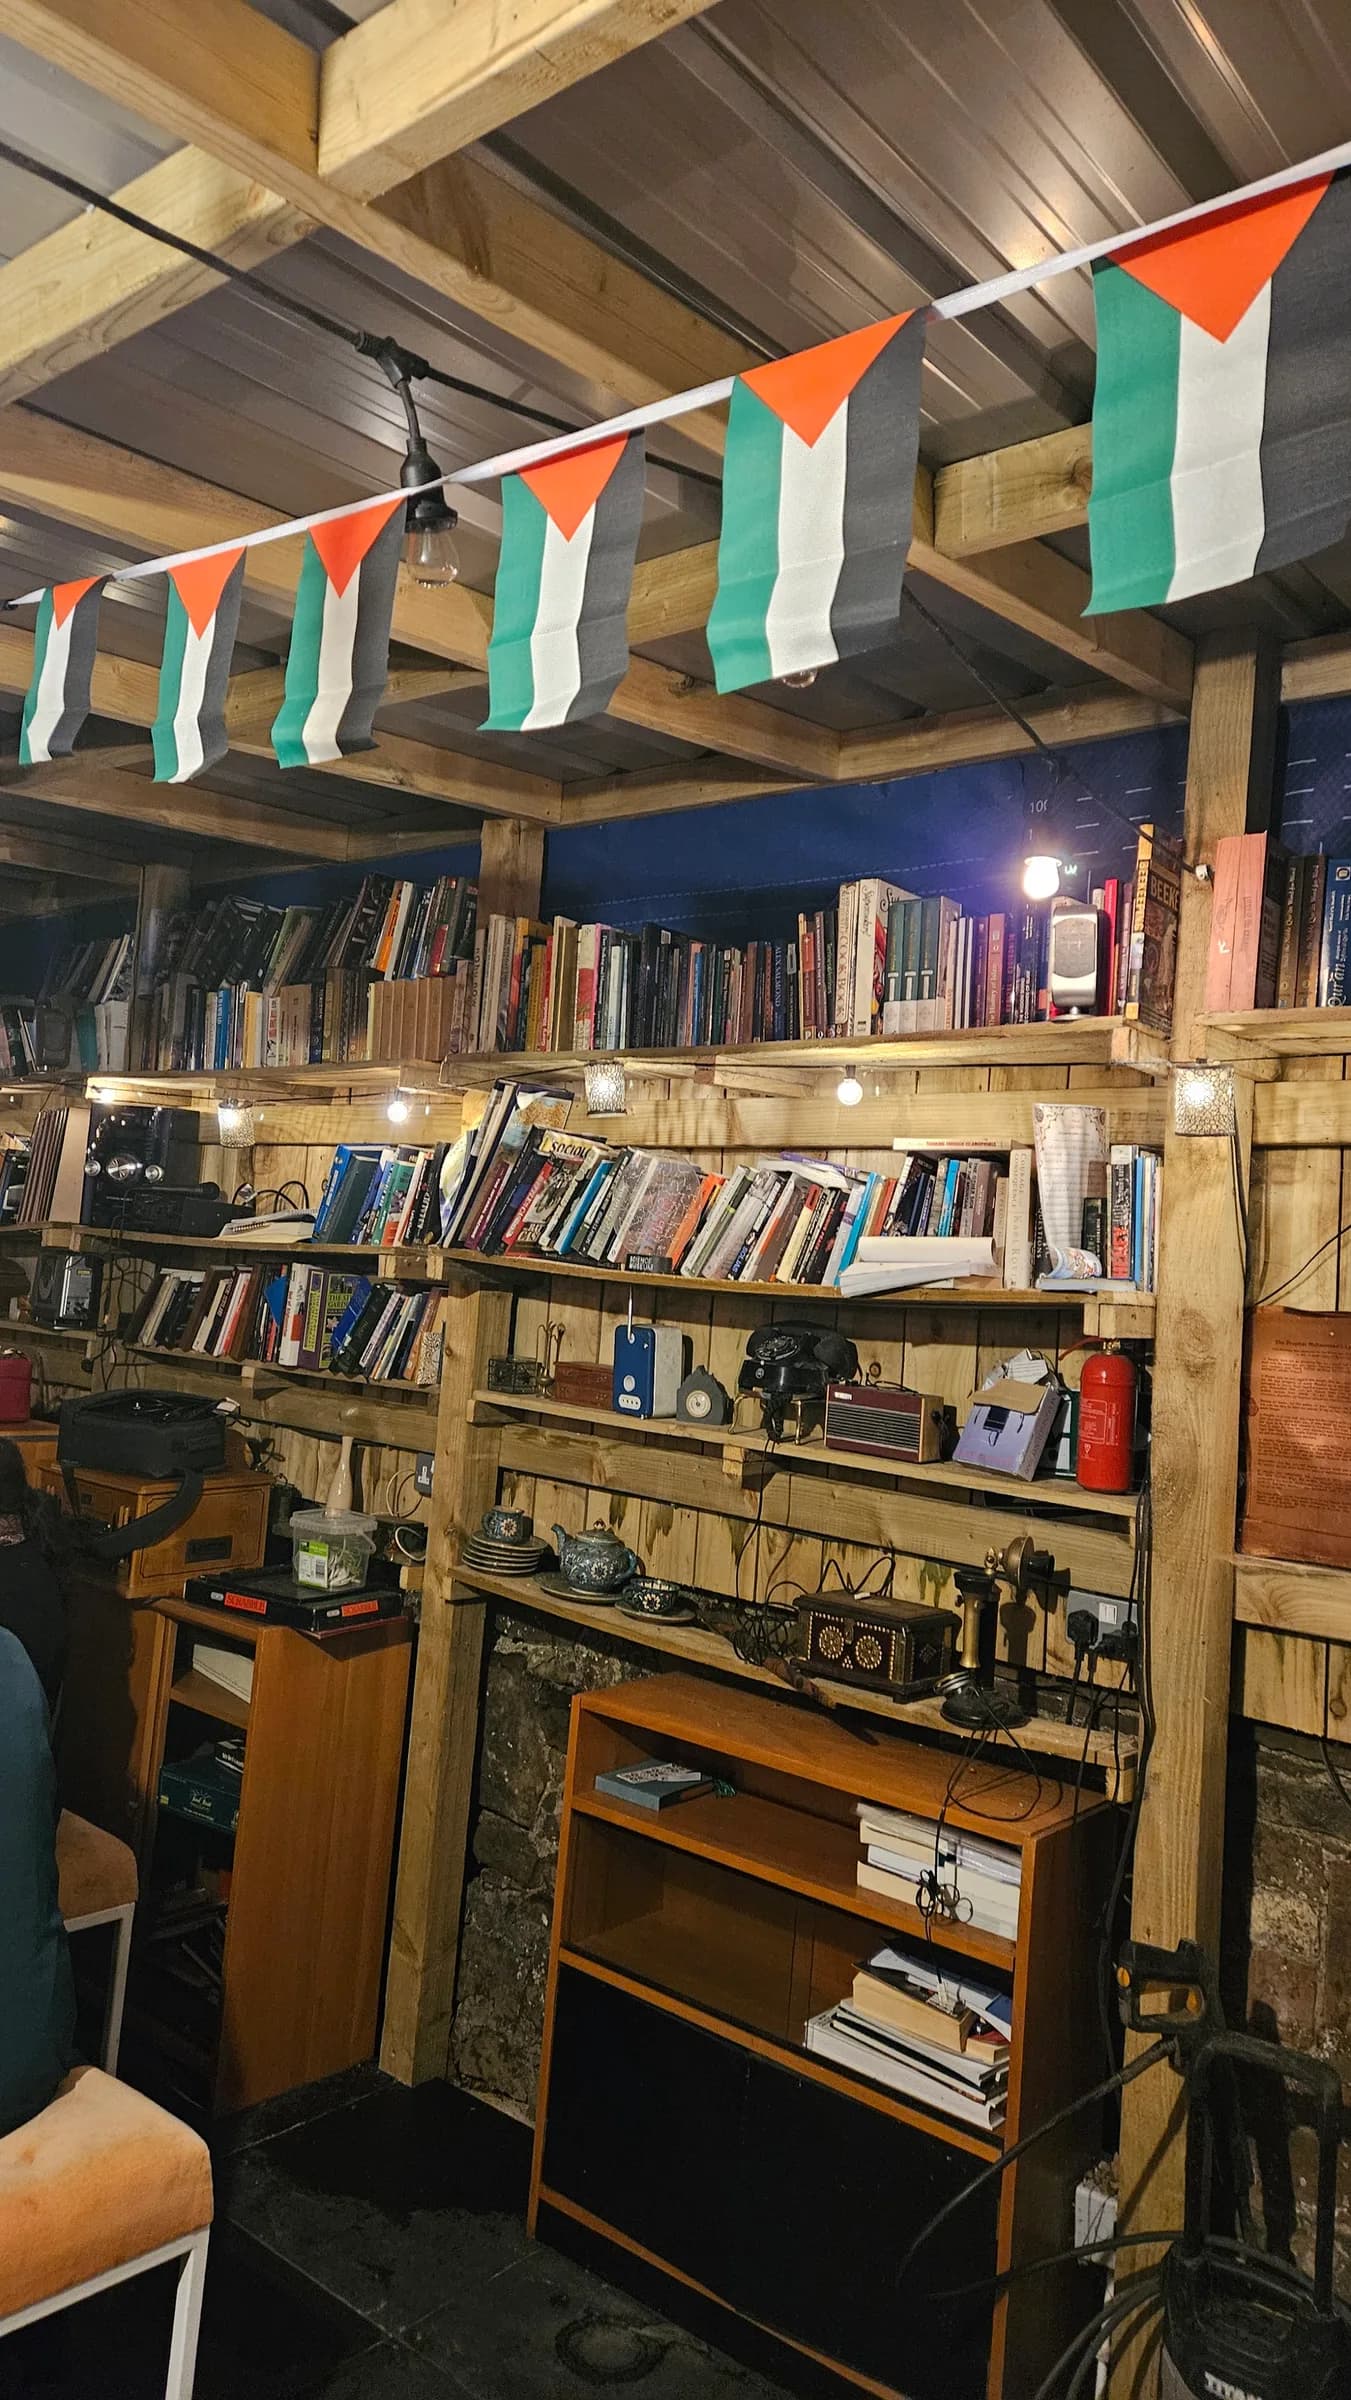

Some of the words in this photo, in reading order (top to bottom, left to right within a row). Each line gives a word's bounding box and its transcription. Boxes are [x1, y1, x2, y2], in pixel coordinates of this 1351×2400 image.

[1134, 860, 1148, 931] BEEKEEPING
[839, 936, 848, 974] COOK
[836, 979, 846, 1017] BOOK
